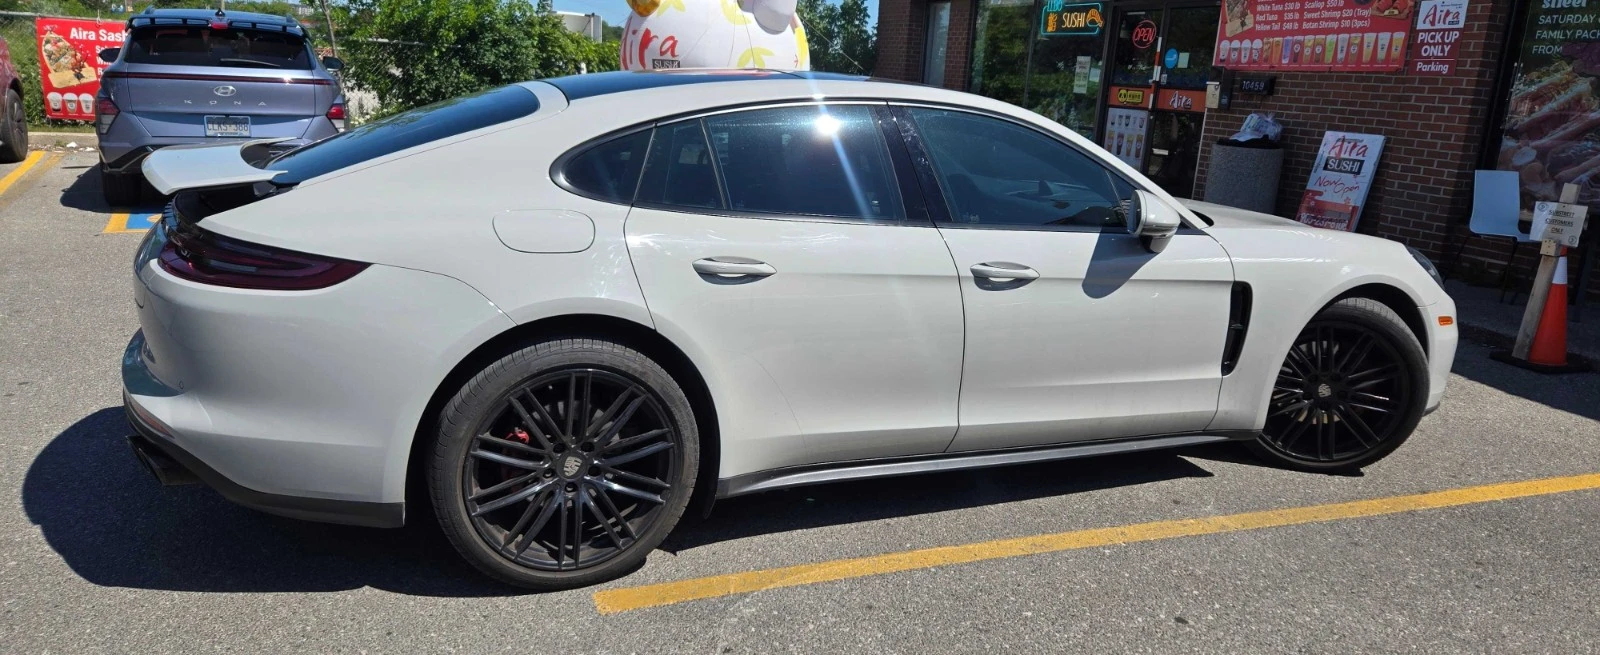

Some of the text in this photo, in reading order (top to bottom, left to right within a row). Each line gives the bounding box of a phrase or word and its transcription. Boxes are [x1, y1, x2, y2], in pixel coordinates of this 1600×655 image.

[1303, 7, 1372, 19] Sweet Shrimp $20 (Tray)
[1422, 4, 1461, 27] Aira
[1538, 14, 1597, 25] SATURDAY
[1061, 12, 1086, 28] SUSHI
[1319, 20, 1340, 29] Shrimp
[69, 27, 96, 41] Aira
[1133, 27, 1155, 42] OPEN
[1417, 31, 1460, 44] PICK UP
[1535, 30, 1573, 39] FAMILY
[1421, 44, 1451, 57] ONLY
[1532, 45, 1563, 54] FROM
[1416, 61, 1449, 74] Parking
[1242, 80, 1265, 91] 10459
[1169, 90, 1192, 109] Aira
[1328, 135, 1369, 160] Aira
[1327, 158, 1361, 172] SUSHI
[1313, 175, 1360, 198] Now Open
